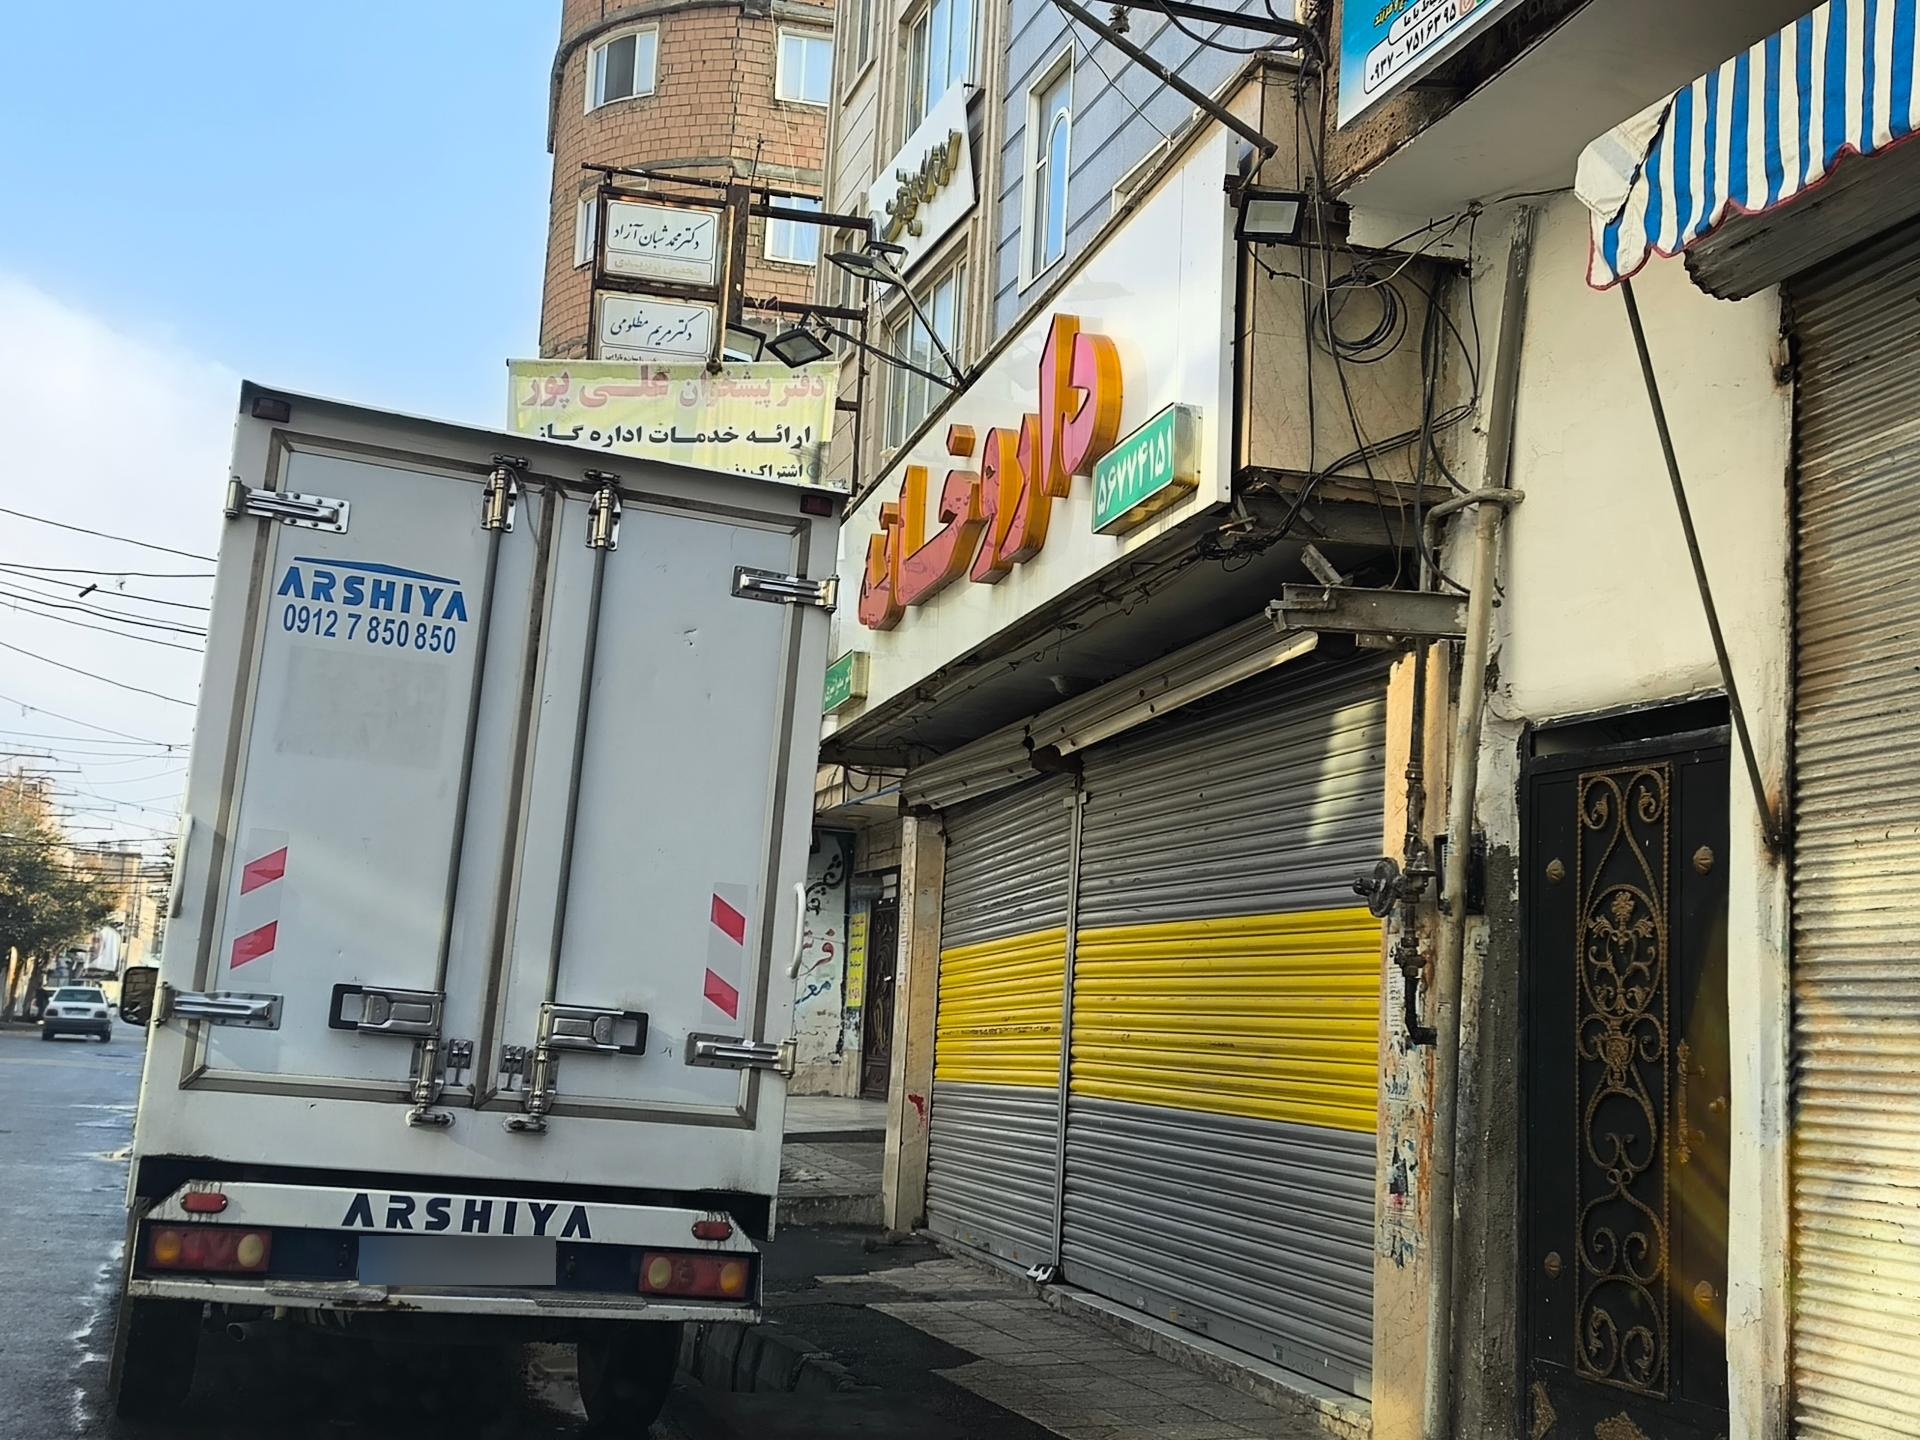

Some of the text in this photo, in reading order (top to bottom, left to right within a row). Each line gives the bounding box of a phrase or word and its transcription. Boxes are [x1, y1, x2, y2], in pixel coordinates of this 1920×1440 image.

[614, 223, 644, 240] آزاد
[674, 219, 711, 251] دکتر
[610, 310, 704, 346] دکتر مریم مظلومی
[521, 371, 570, 408] پور
[579, 364, 670, 408] علی
[777, 367, 825, 407] دفتر
[590, 425, 642, 447] اداره
[649, 425, 739, 443] خدمات
[746, 424, 811, 449] ارائه
[858, 313, 1122, 631] داروخانه
[277, 566, 468, 622] ARSHIYA
[283, 604, 338, 638] 0912
[347, 613, 362, 640] 7
[341, 1192, 592, 1239] ARSHIYA
